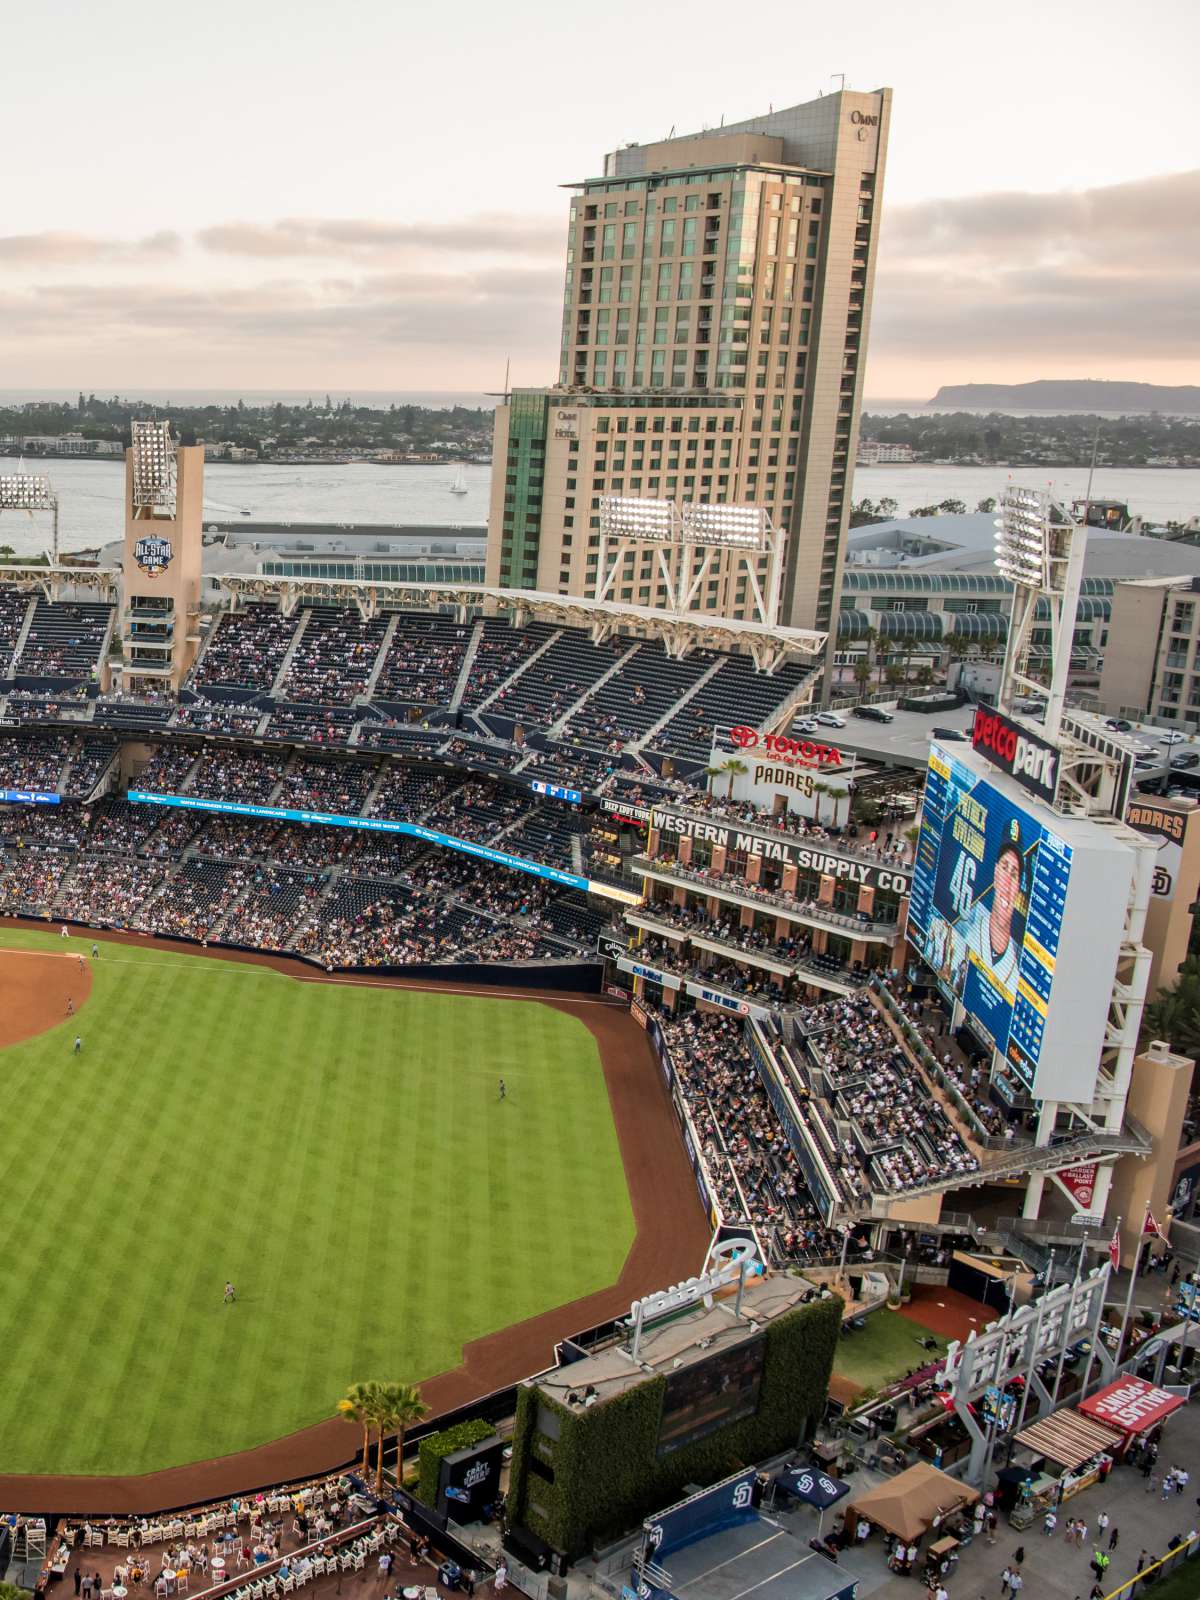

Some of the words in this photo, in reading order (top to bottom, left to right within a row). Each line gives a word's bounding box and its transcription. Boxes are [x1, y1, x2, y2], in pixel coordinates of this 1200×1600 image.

[136, 543, 171, 559] ALL-STAR
[143, 556, 163, 564] GAME
[765, 734, 842, 766] TOYOTA
[973, 710, 1017, 762] petco
[1013, 736, 1056, 789] park
[754, 765, 815, 799] PADRES
[653, 811, 729, 846] WESTERN
[735, 832, 793, 865] METAL
[798, 852, 870, 885] SUPPLY
[879, 871, 911, 896] CO.
[950, 850, 977, 920] 46
[1111, 1387, 1175, 1425] BALLAST
